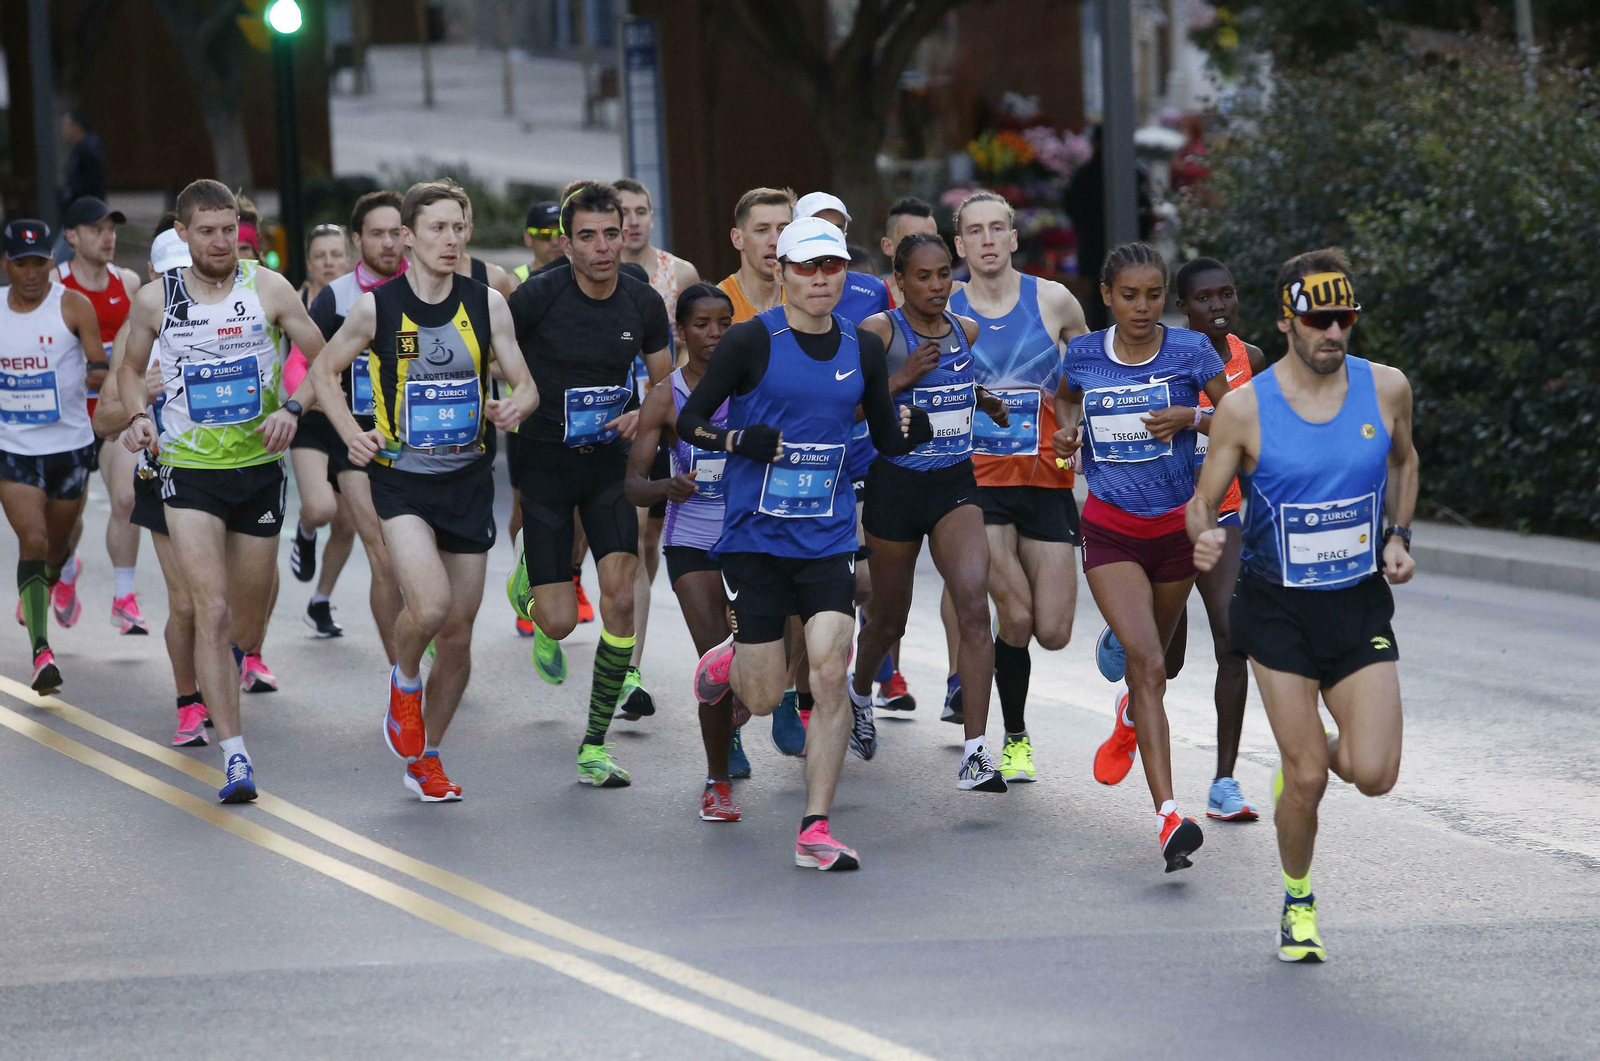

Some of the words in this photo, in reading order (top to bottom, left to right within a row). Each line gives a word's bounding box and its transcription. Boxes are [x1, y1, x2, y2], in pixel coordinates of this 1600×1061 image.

[219, 341, 250, 350] BOTTICO
[1, 357, 48, 370] PERU
[213, 366, 242, 375] ZURICH
[216, 385, 232, 397] 94
[438, 389, 467, 397] ZURICH
[596, 393, 620, 402] ZURICH
[943, 394, 967, 403] ZURICH
[1003, 398, 1023, 406] RICH
[1116, 395, 1149, 405] ZURICH
[438, 408, 455, 420] 84
[595, 412, 608, 425] 57
[937, 428, 961, 437] BEGNA
[1112, 431, 1148, 441] TSEGAW
[801, 454, 830, 462] ZURICH
[798, 474, 812, 487] 51
[1321, 509, 1357, 522] ZURICH
[1317, 549, 1348, 561] PEACE
